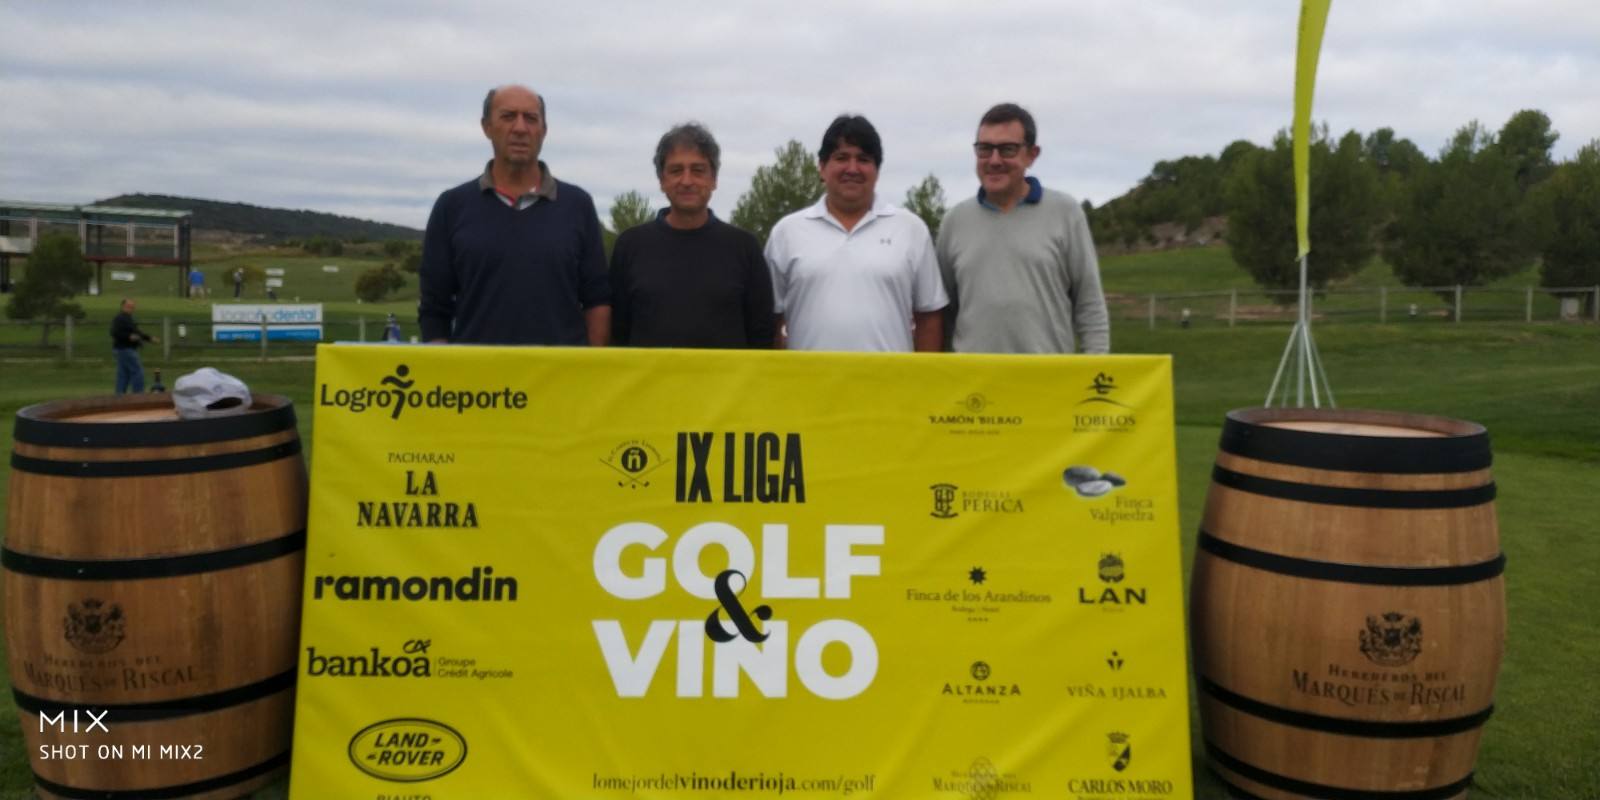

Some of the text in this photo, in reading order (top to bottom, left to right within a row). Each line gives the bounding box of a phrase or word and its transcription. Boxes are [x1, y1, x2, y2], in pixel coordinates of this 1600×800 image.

[426, 385, 528, 414] deporte
[675, 431, 806, 503] IX LIGA
[405, 471, 438, 496] LA
[962, 498, 1025, 513] PERICA
[1115, 496, 1154, 509] Finca
[356, 501, 479, 528] NAVARRA
[1089, 507, 1154, 525] Valpiedra
[592, 521, 885, 600] GOLF
[313, 566, 518, 602] ramondin
[1078, 586, 1147, 605] LAN
[704, 568, 773, 643] &
[906, 588, 1052, 604] Finca de los Arandinos
[306, 647, 432, 678] bankoa
[438, 657, 476, 668] Groupe
[591, 618, 880, 701] VINO
[122, 665, 199, 692] RISCAL
[471, 668, 514, 680] Agricole
[942, 683, 1022, 697] ALTANZA
[1066, 684, 1167, 700] VIÑA IJALBA
[1410, 682, 1466, 705] RISCAL
[377, 750, 445, 766] ROVER
[592, 771, 876, 795] lomejordelvinoderioja.com/golf
[1067, 779, 1173, 794] CARLOS MORO
